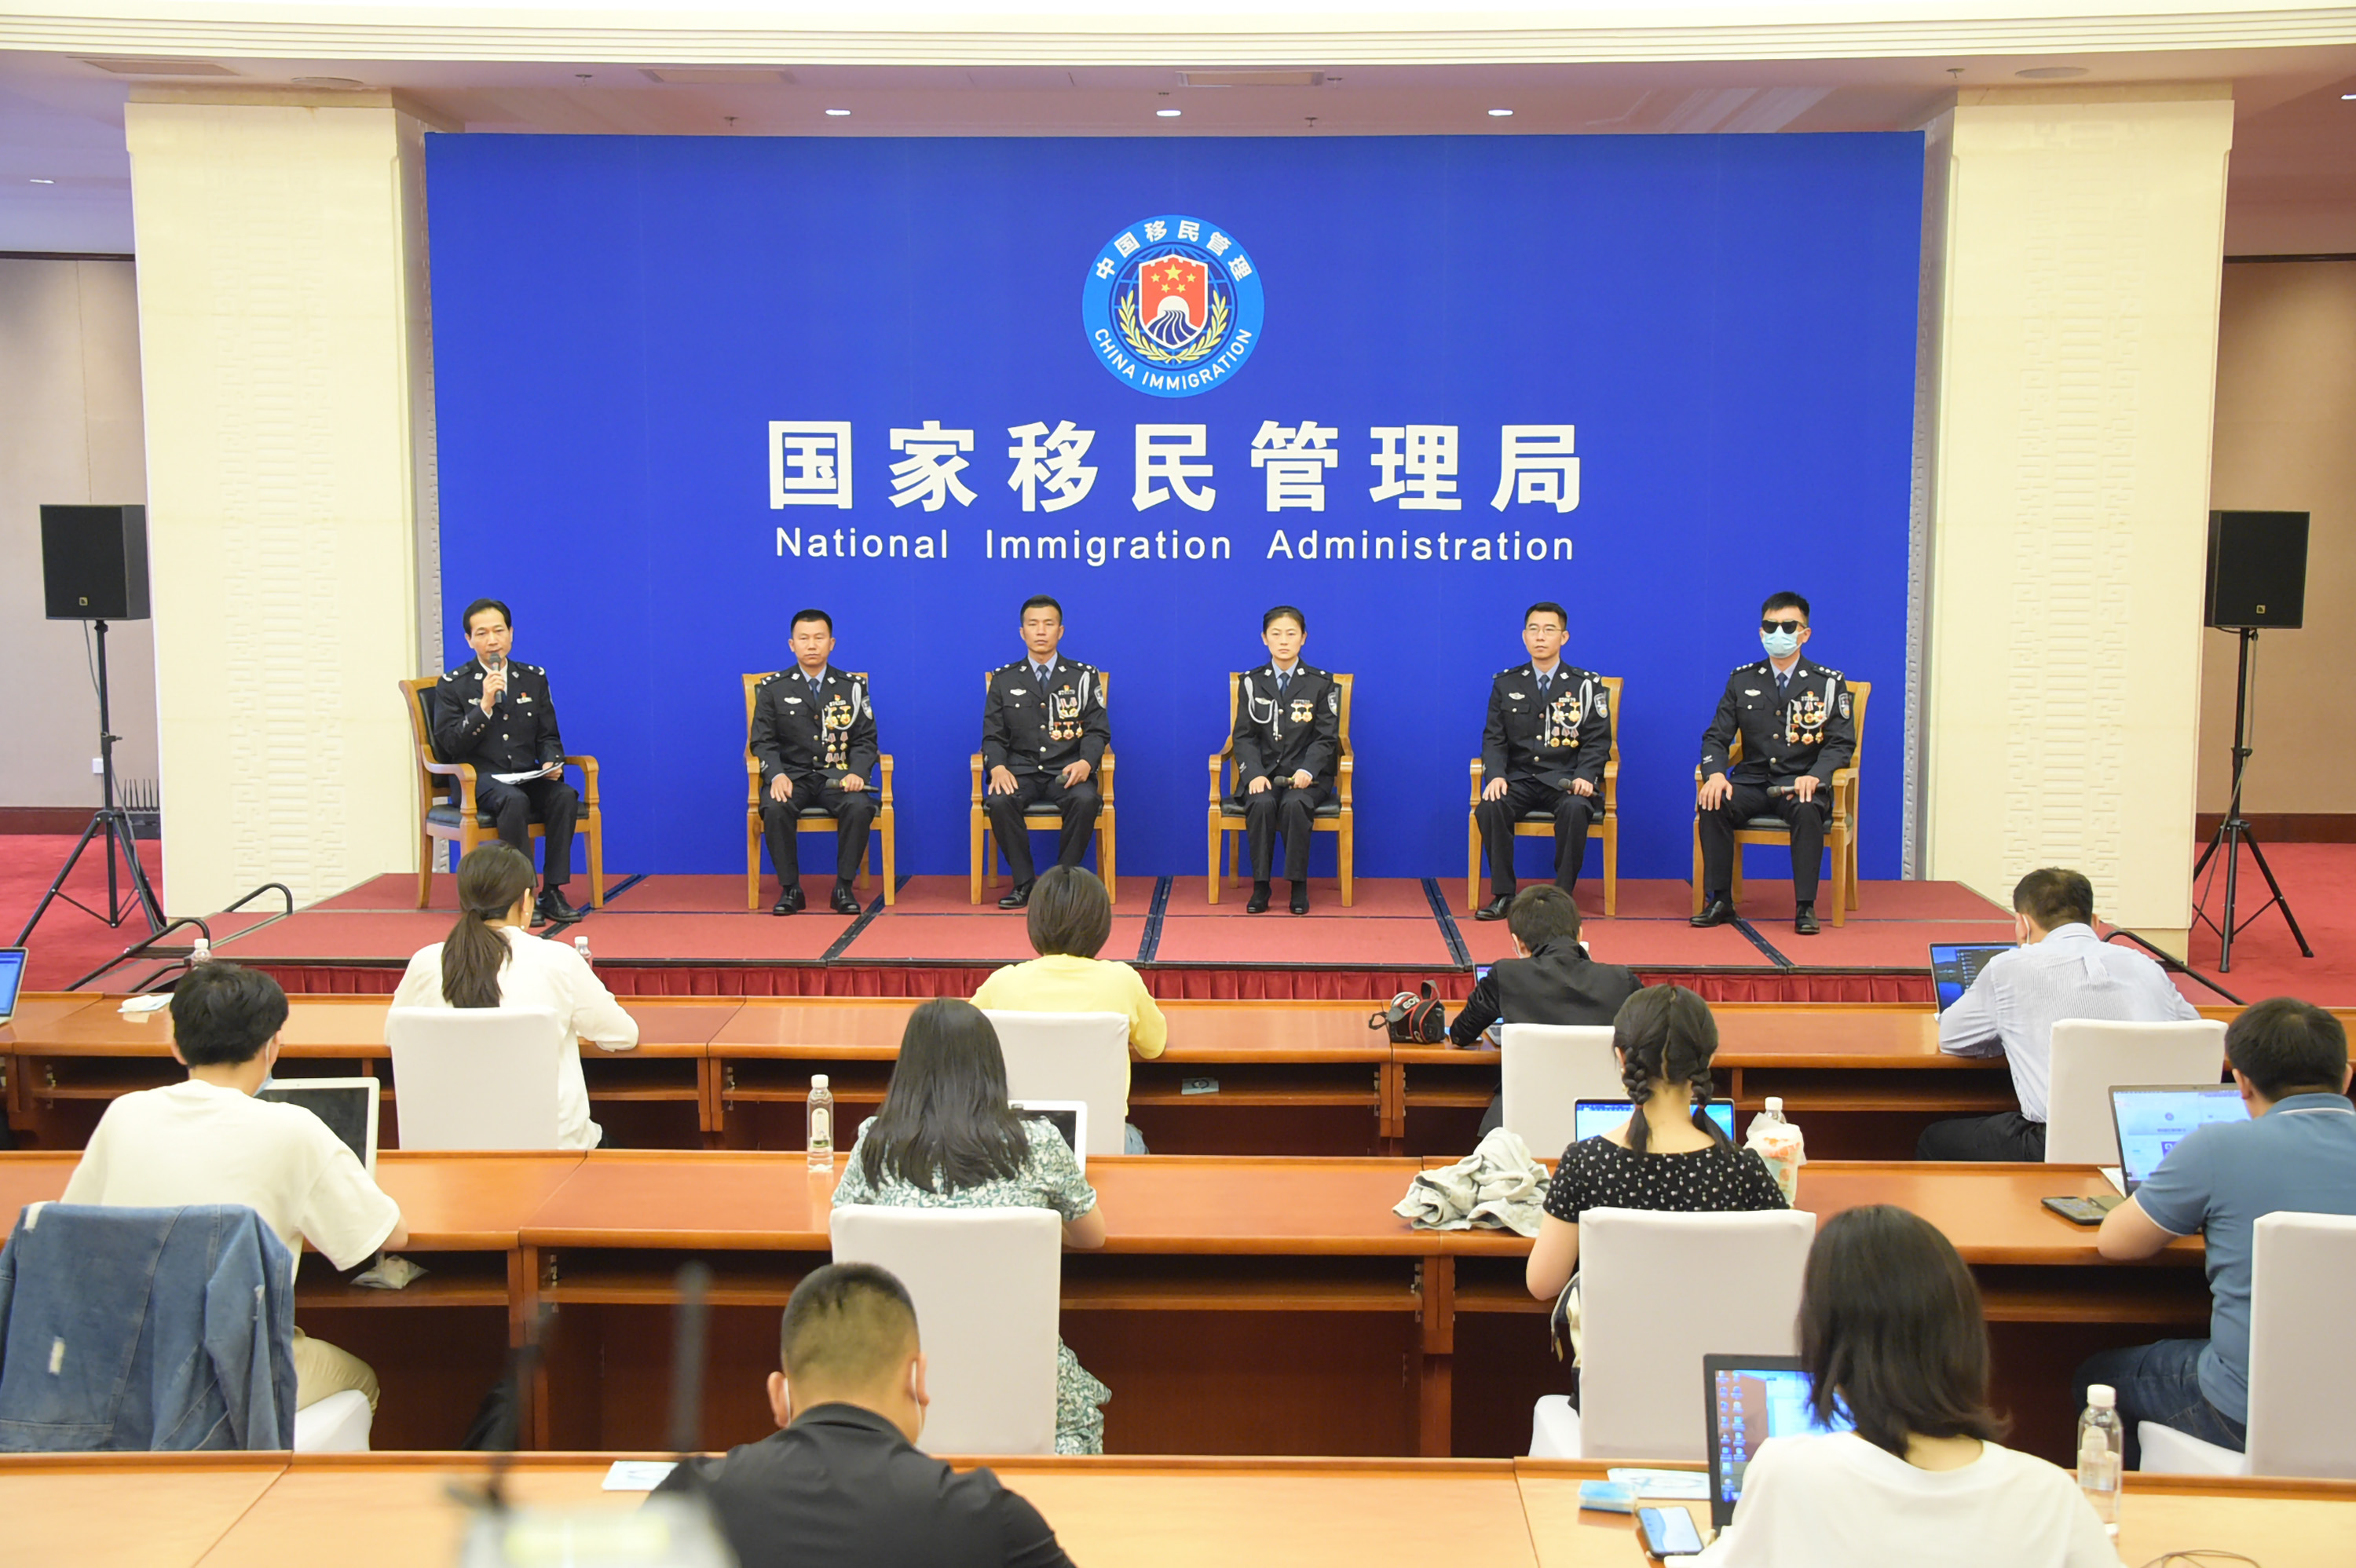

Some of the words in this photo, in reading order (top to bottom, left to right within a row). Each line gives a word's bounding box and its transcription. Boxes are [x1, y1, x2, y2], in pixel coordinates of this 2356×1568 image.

[1096, 219, 1253, 282] 中国移民管理
[1095, 328, 1136, 379] CHINA
[1142, 328, 1253, 391] IMMIGRATION
[768, 420, 1580, 514] 国家移民管理局
[776, 527, 947, 559] National
[986, 529, 1231, 567] Immigration
[1266, 529, 1573, 561] Administration
[1403, 996, 1420, 1009] EOS
